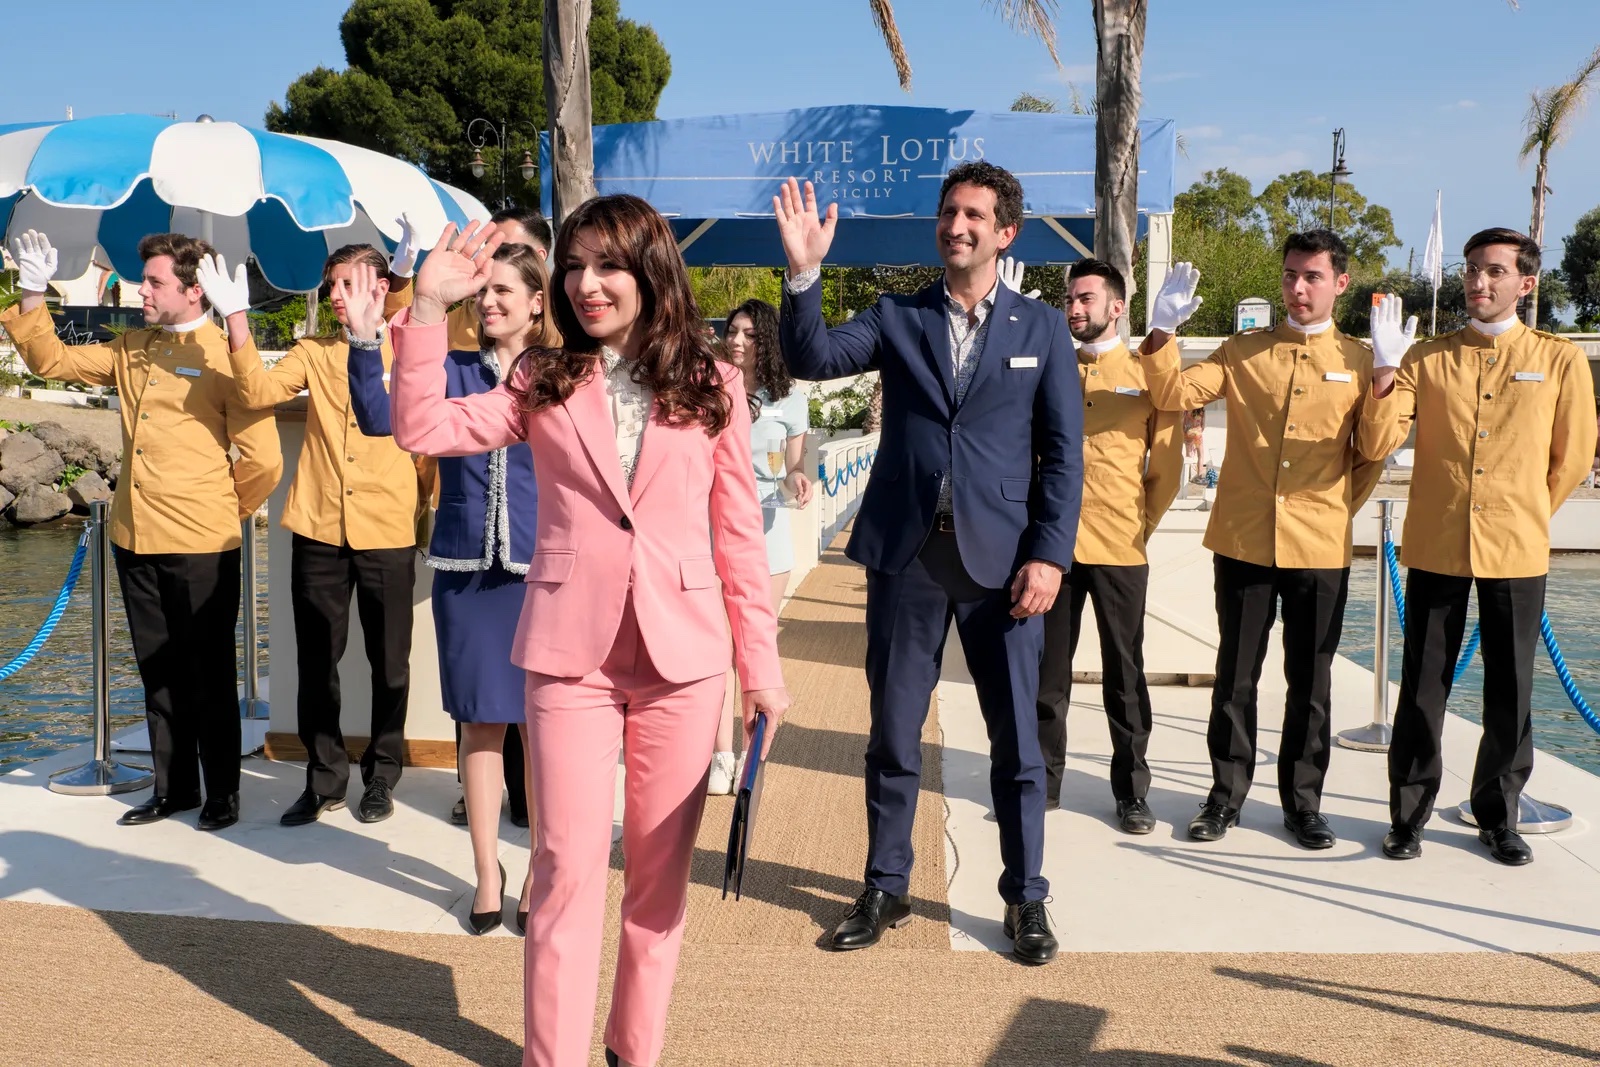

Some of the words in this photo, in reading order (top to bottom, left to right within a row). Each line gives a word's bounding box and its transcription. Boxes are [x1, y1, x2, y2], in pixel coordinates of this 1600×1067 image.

[748, 141, 853, 164] WHITE
[881, 135, 985, 165] LOTUS
[814, 168, 910, 184] RESORT
[832, 188, 892, 199] SICILY
